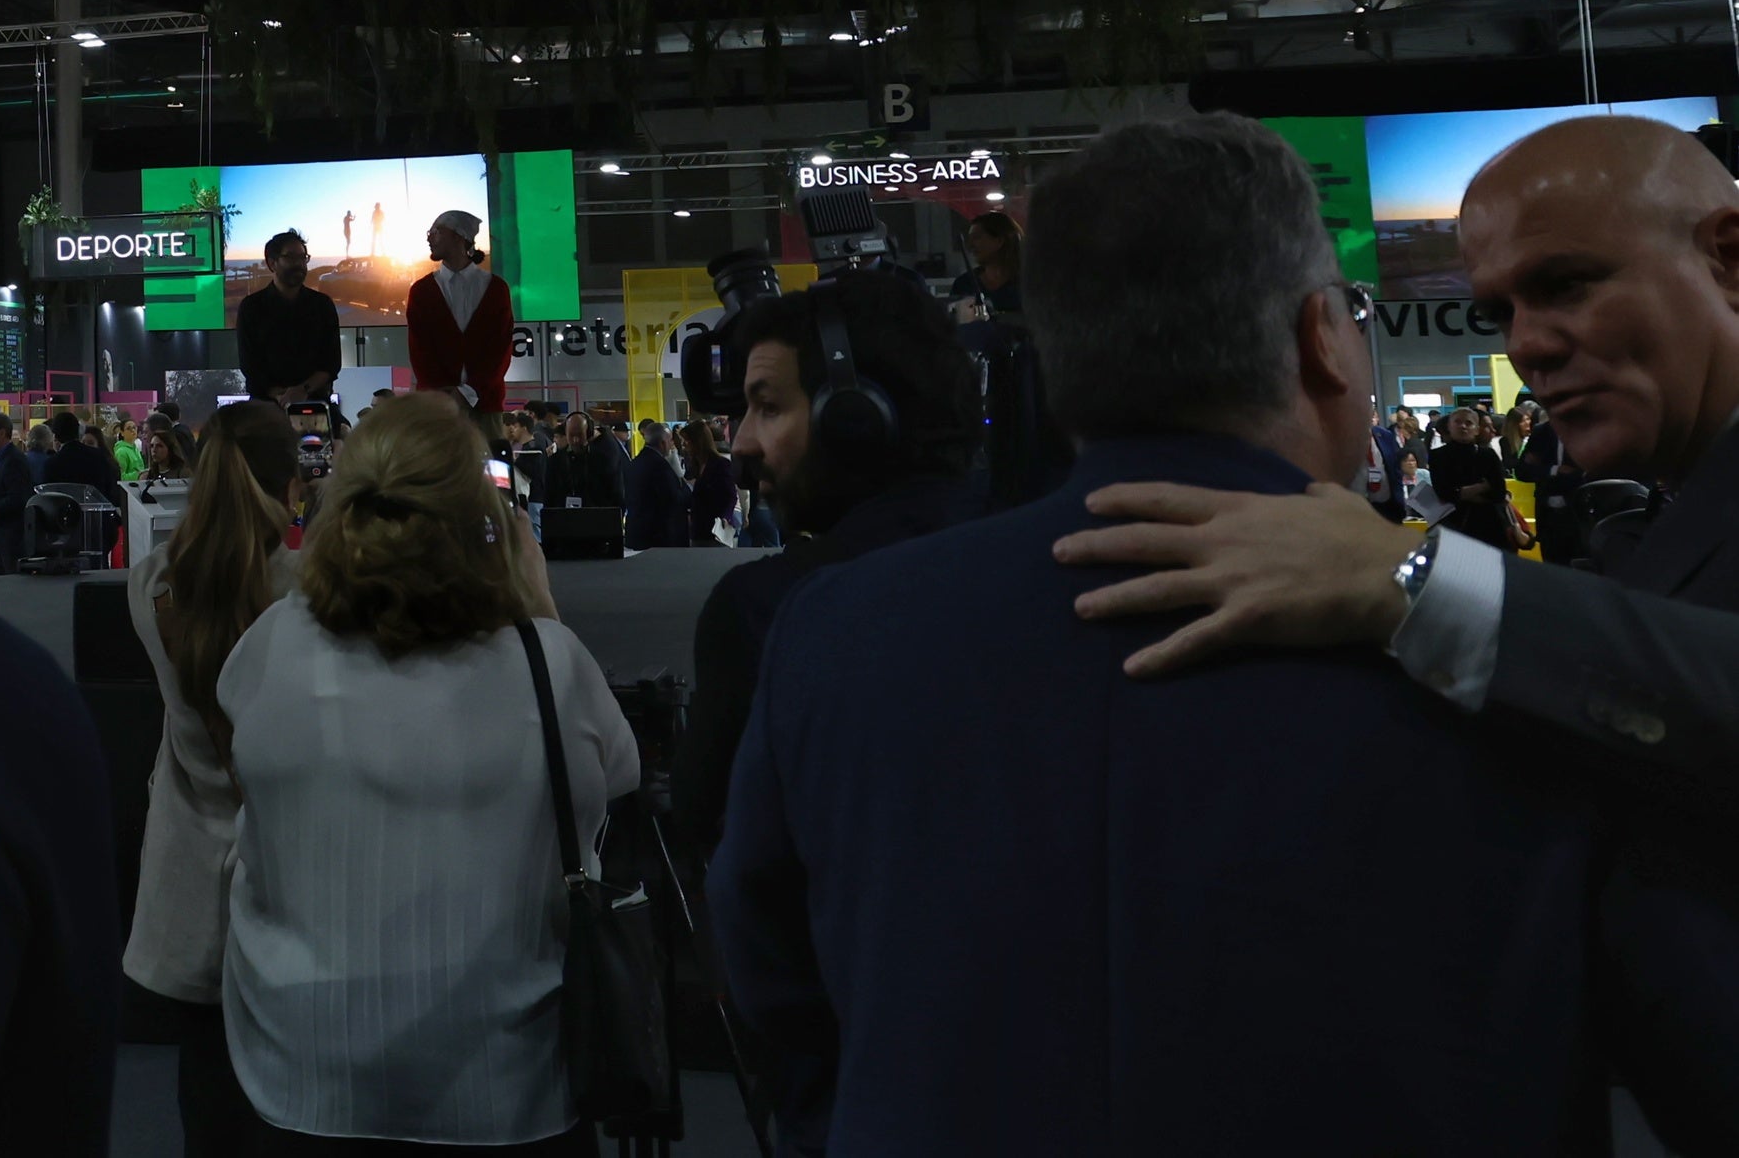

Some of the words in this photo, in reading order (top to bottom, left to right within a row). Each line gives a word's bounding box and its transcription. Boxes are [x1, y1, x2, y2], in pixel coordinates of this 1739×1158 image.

[884, 83, 914, 123] B
[799, 163, 918, 188] BUSINESS
[932, 158, 1001, 180] AREA
[57, 232, 187, 261] DEPORTE
